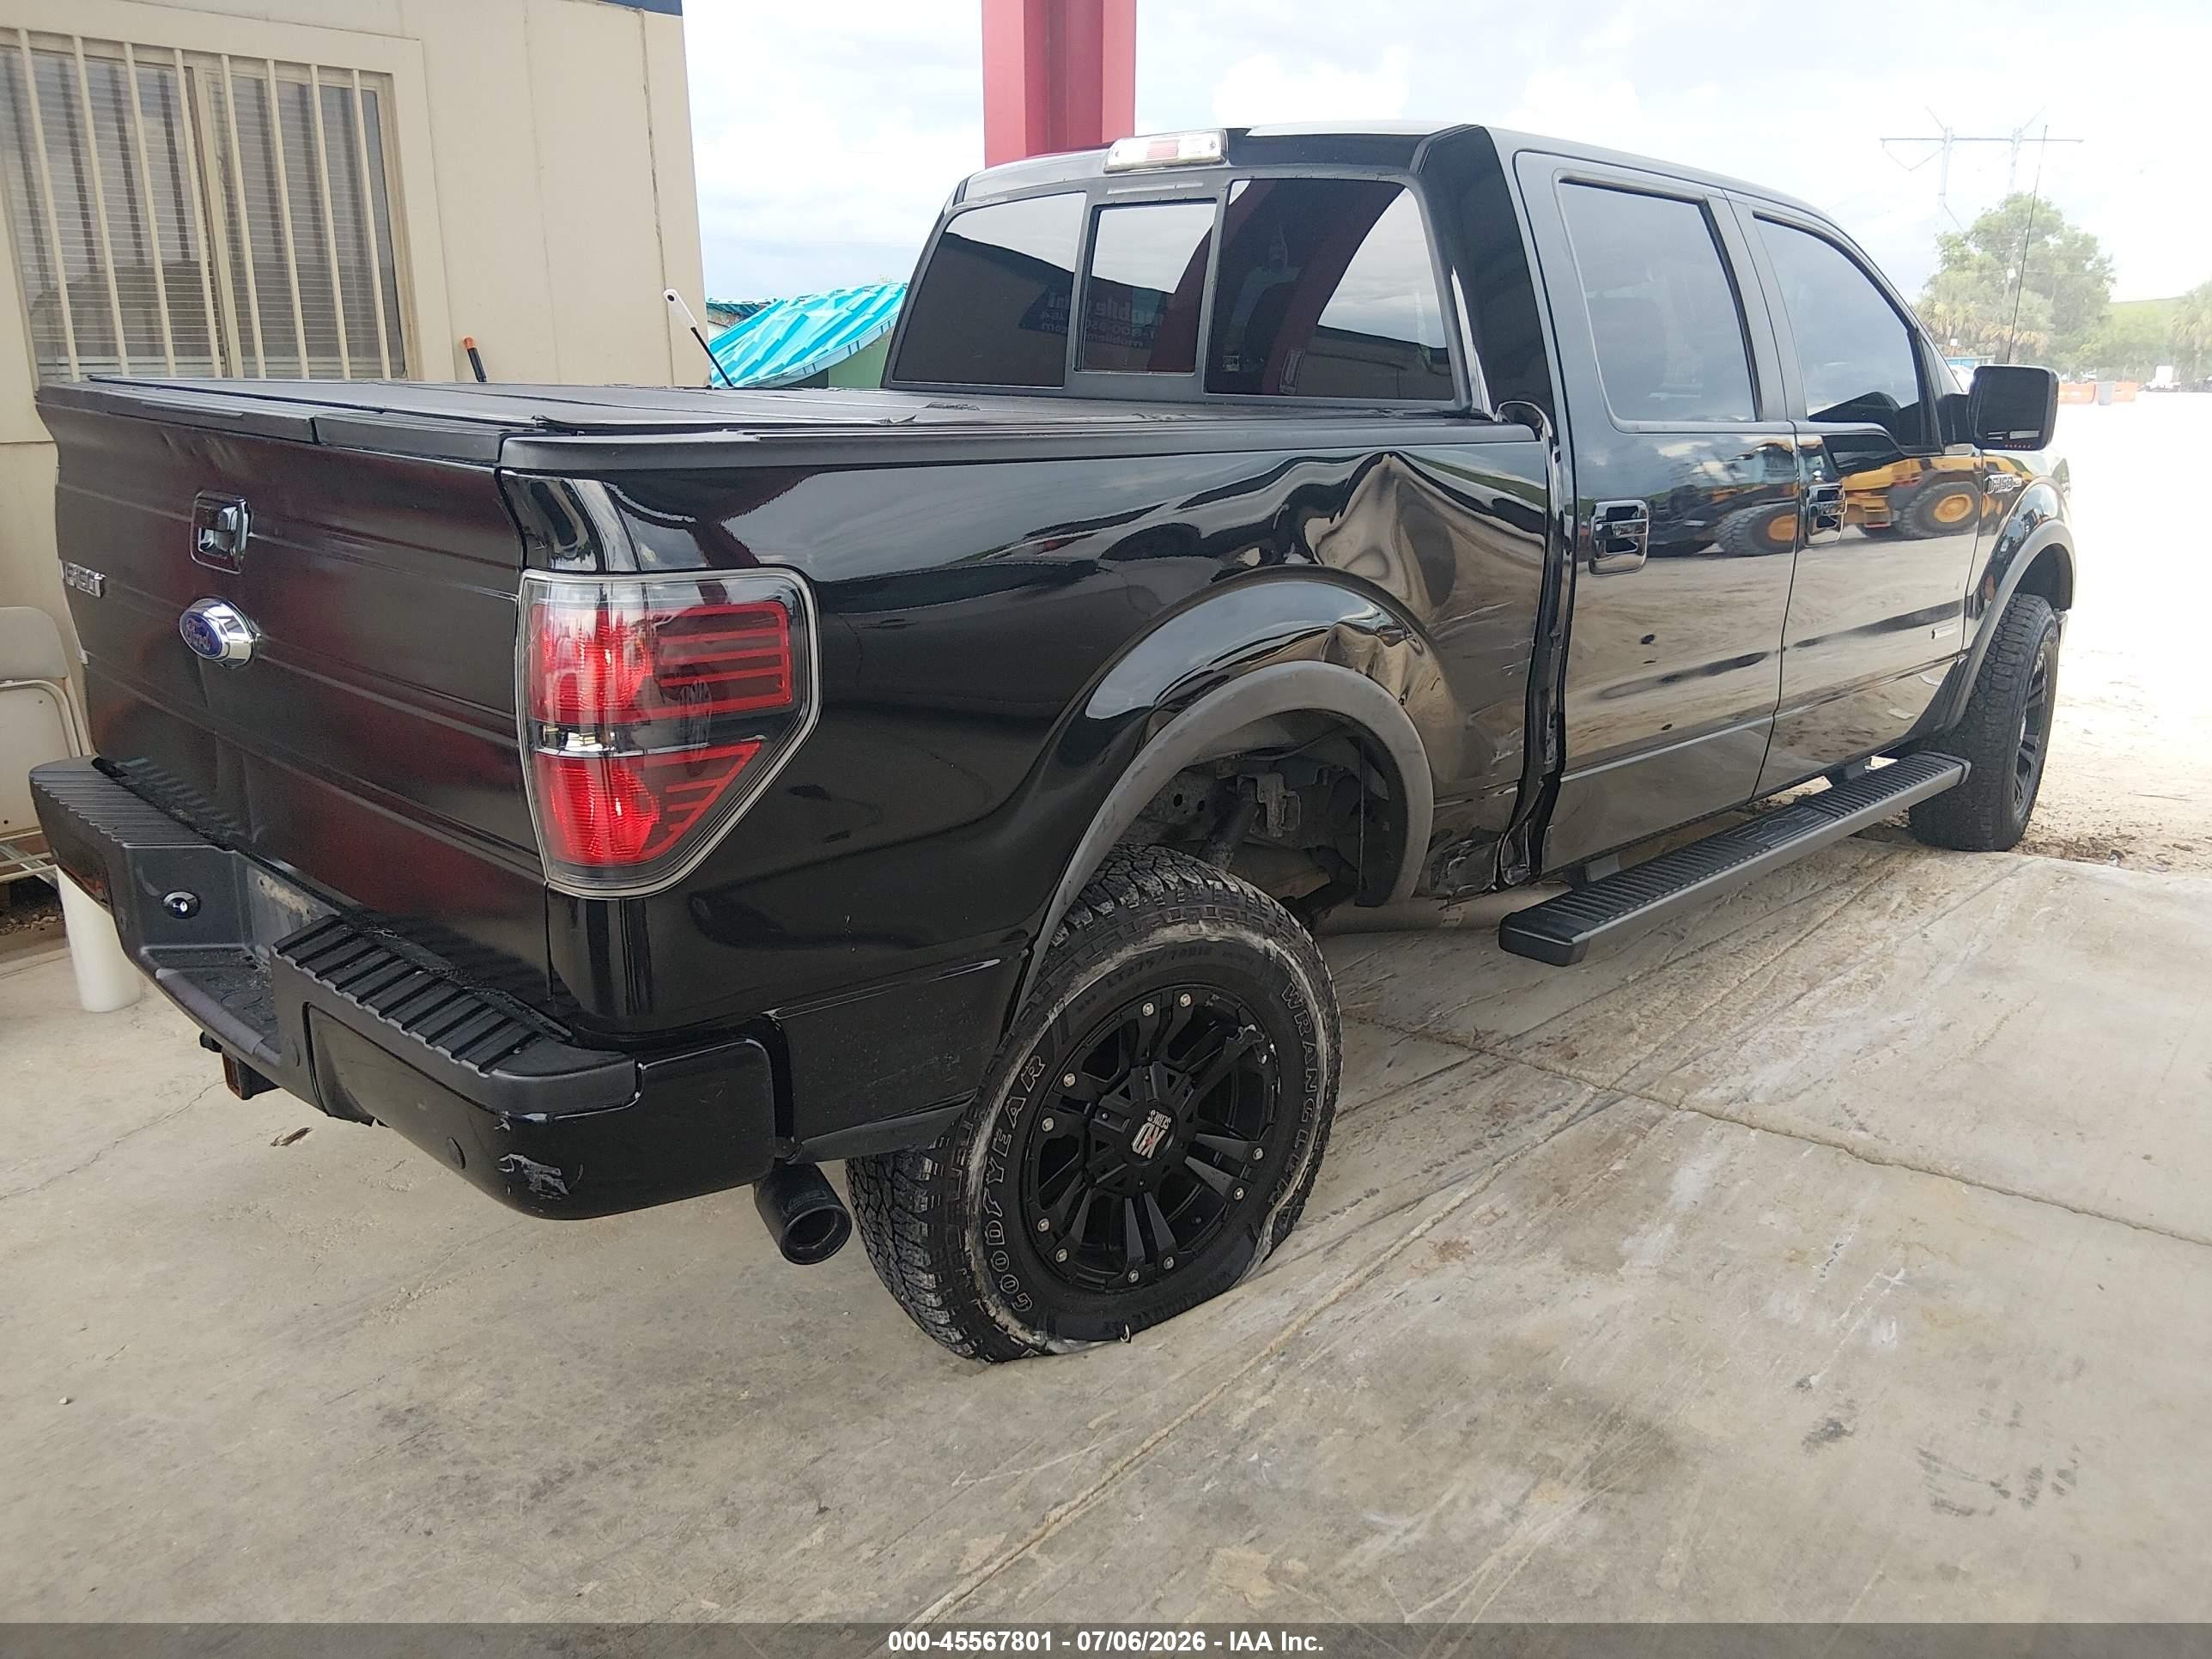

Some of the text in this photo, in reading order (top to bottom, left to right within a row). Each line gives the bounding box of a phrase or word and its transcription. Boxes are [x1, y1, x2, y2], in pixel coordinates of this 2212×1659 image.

[185, 617, 212, 652] Ford
[1279, 983, 1318, 1199] WRANGLER
[1147, 1109, 1172, 1130] SERIES
[1132, 1122, 1166, 1158] XD
[981, 1054, 1048, 1313] GOODYEAR
